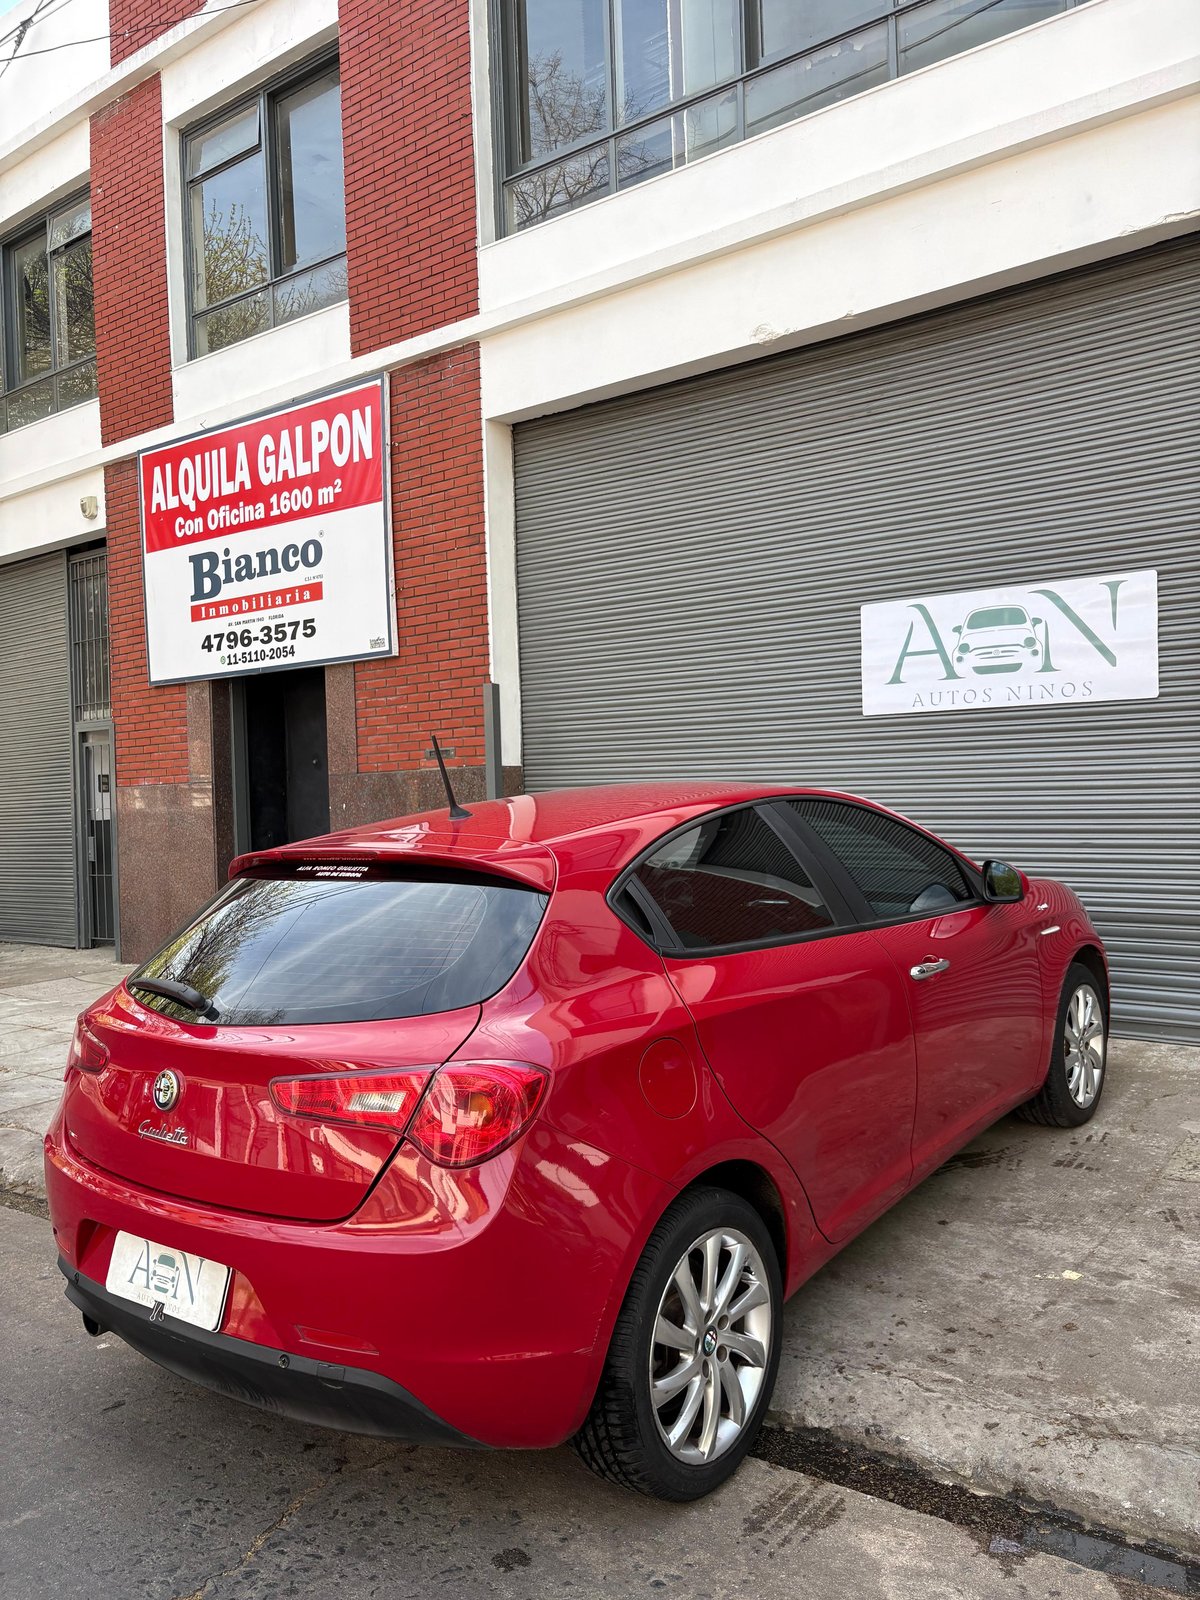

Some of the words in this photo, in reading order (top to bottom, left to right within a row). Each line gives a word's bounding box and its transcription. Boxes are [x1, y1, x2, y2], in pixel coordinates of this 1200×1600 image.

[151, 441, 252, 514] ALQUILA
[257, 405, 373, 486] GALPON
[174, 514, 204, 538] Con
[207, 499, 265, 531] Oficina
[269, 485, 312, 517] 1600
[188, 538, 323, 602] Bianco
[200, 589, 311, 619] Inmobiliaria
[201, 617, 317, 653] 4796-3575
[226, 644, 296, 666] 11-5110-2054
[912, 686, 993, 708] AUTOS
[1007, 681, 1093, 702] NINOS
[138, 1119, 189, 1145] Giulietta
